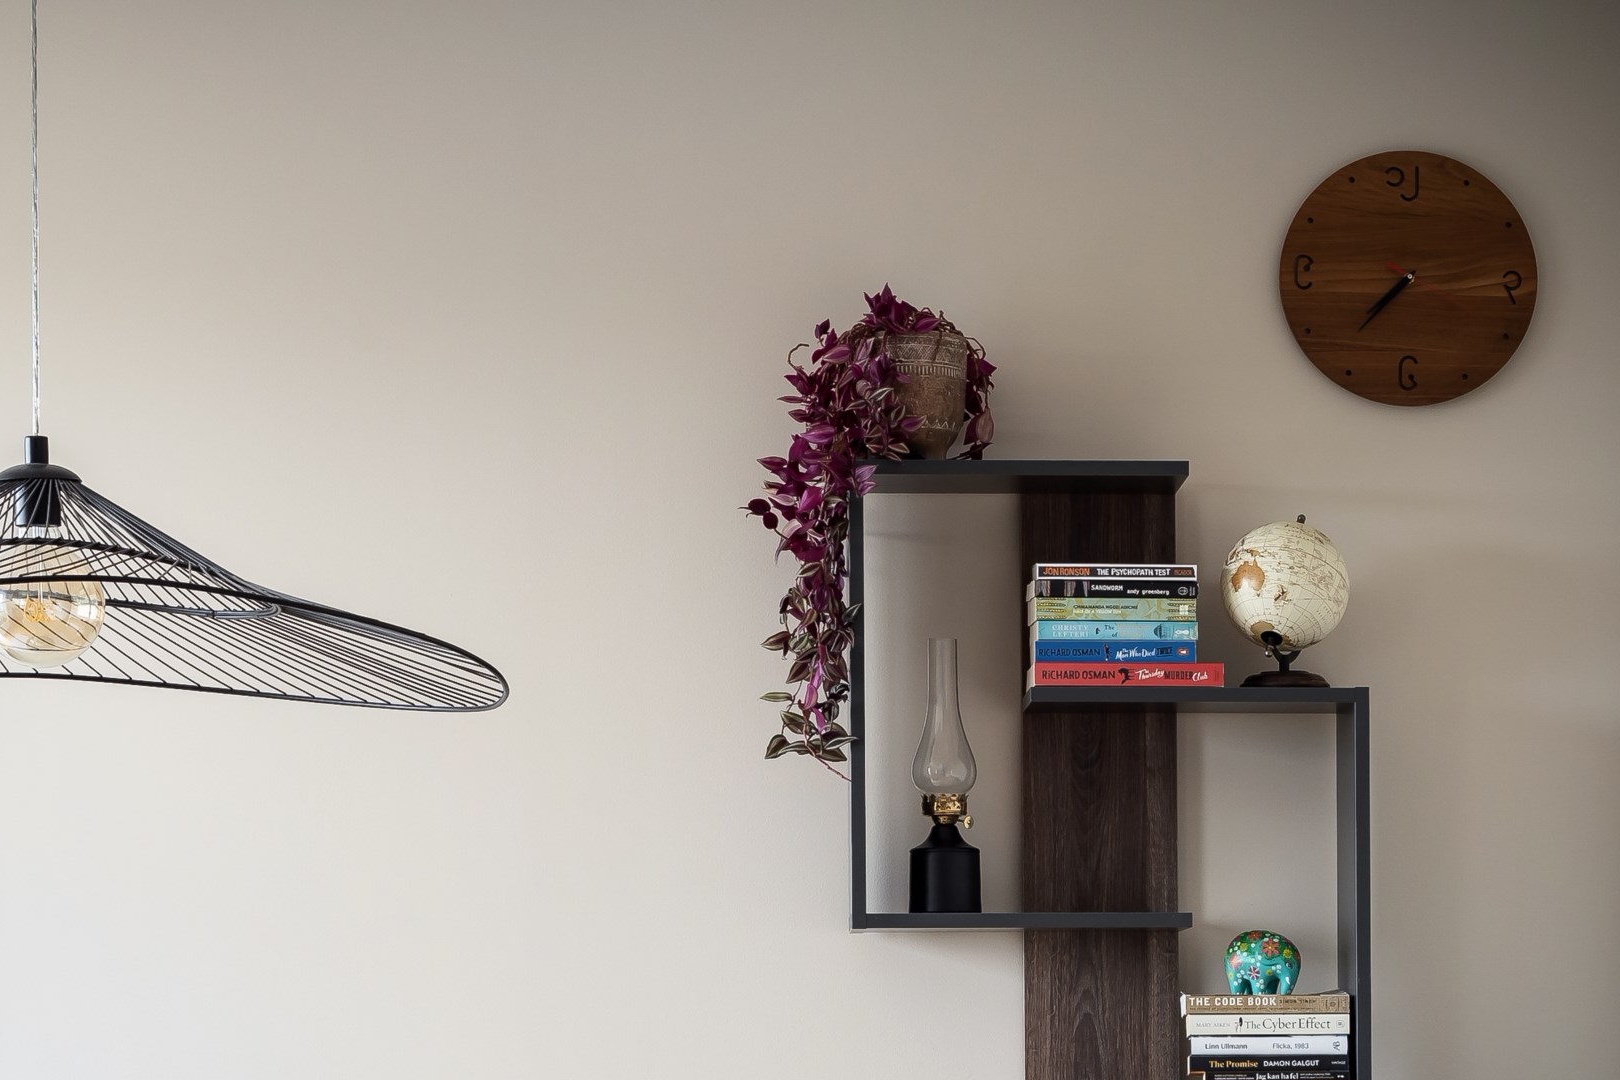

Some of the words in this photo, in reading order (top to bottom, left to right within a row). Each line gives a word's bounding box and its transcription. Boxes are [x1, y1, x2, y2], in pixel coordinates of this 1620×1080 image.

[1043, 567, 1059, 576] JON
[1060, 567, 1090, 576] RONSON
[1096, 568, 1109, 576] THE
[1111, 568, 1153, 576] PSYCHOPATH
[1155, 568, 1171, 576] TEST
[1142, 588, 1170, 596] greenberg
[1072, 648, 1101, 656] OSMAN
[1115, 650, 1129, 661] Man
[1081, 670, 1116, 679] OSMAN
[1135, 668, 1165, 680] Thursday
[1164, 671, 1193, 680] MURDER
[1189, 997, 1210, 1006] THE
[1215, 997, 1243, 1006] CODE
[1248, 996, 1276, 1006] BOOK
[1244, 1020, 1261, 1029] The
[1262, 1018, 1297, 1032] Cyber
[1298, 1017, 1331, 1029] Effect
[1294, 1042, 1309, 1050] 1983
[1209, 1060, 1225, 1068] The
[1226, 1060, 1259, 1068] Promise
[1291, 1059, 1320, 1067] GALGUT
[1255, 1072, 1266, 1080] Jag
[1267, 1072, 1280, 1080] kan
